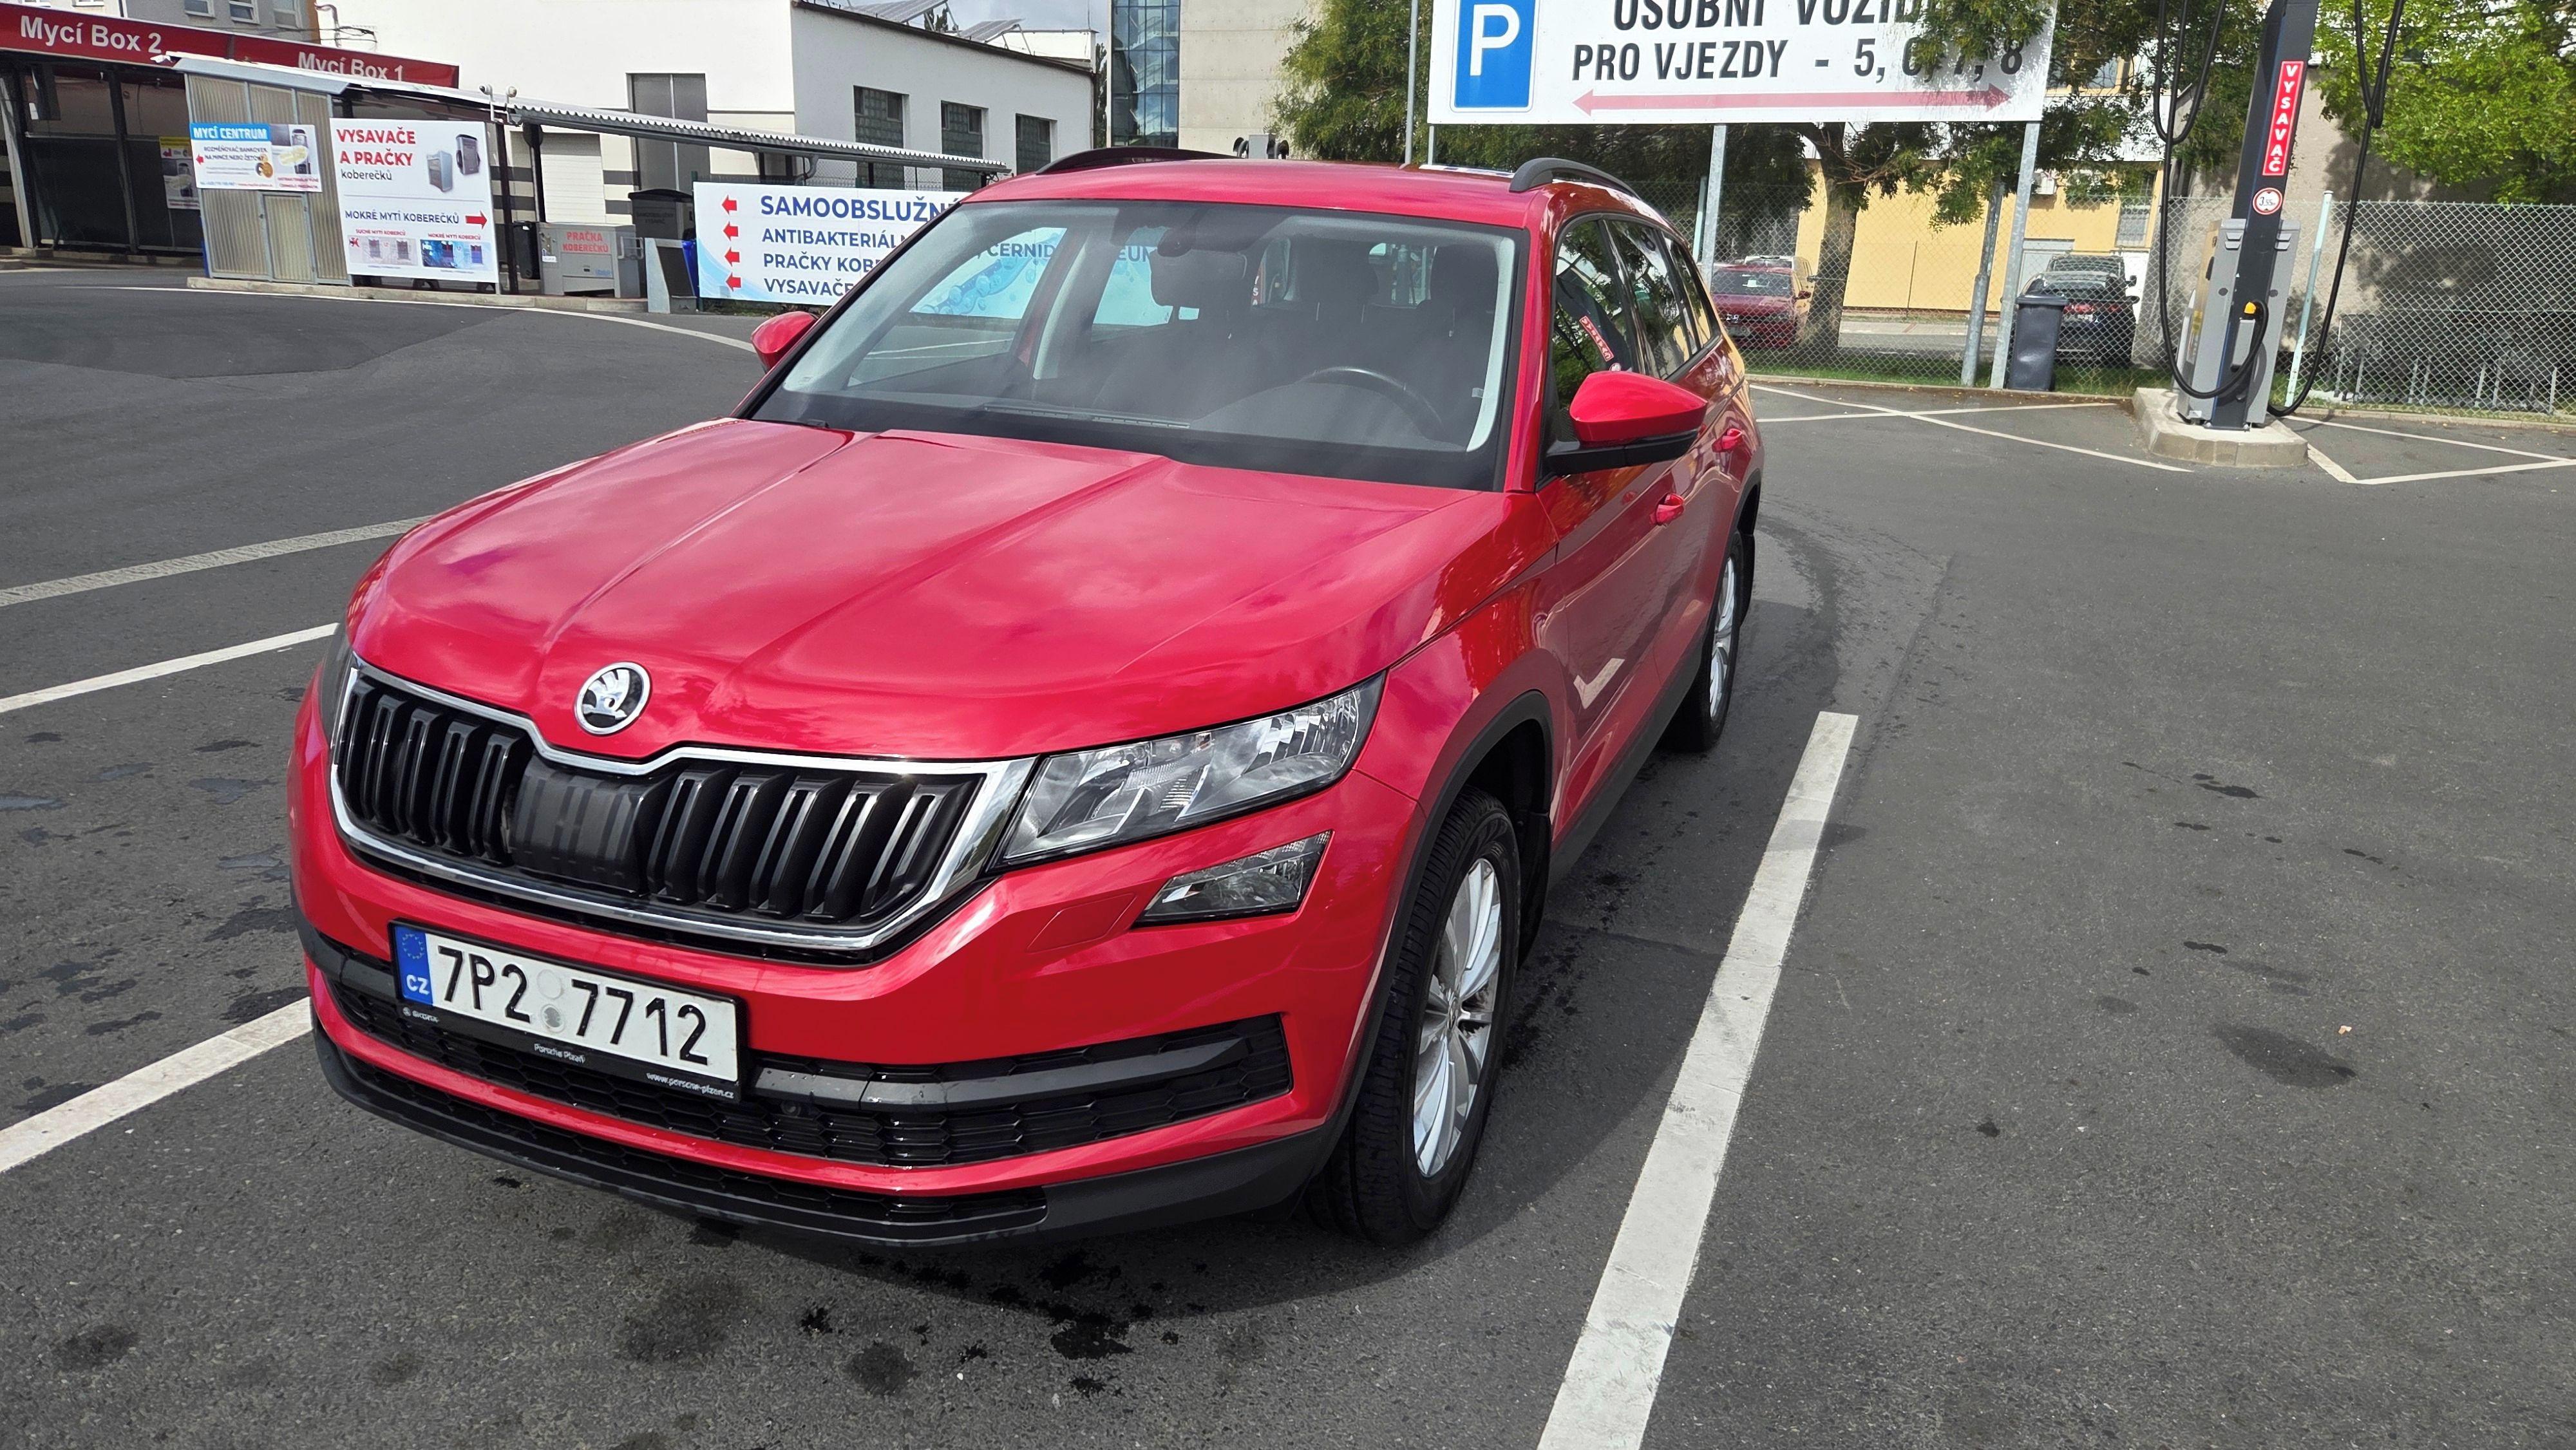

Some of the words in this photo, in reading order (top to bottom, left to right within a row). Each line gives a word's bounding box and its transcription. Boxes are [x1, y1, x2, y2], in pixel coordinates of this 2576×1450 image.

[21, 15, 83, 46] Mycí
[91, 24, 141, 52] Box
[148, 32, 162, 53] 2
[1470, 3, 1520, 76] P
[298, 52, 346, 74] Mycí
[350, 59, 388, 80] Box
[394, 65, 404, 81] 1
[1571, 42, 1640, 81] PRO
[1654, 39, 1788, 80] VJEZDY
[1854, 38, 1885, 84] 5,
[2000, 37, 2024, 75] 8
[2268, 64, 2298, 172] VYSAVAČ
[193, 126, 218, 138] MYCÍ
[220, 128, 268, 140] CENTRUM
[336, 127, 416, 145] VYSAVAČE
[339, 151, 351, 164] A
[354, 148, 413, 165] PRAČKY
[341, 169, 392, 180] koberečků
[345, 209, 377, 220] MOKRÉ
[380, 210, 401, 221] MYTÍ
[404, 212, 459, 224] KOBEREČKŮ
[567, 230, 603, 241] PRAČKA
[763, 251, 832, 271] PRAČKY
[406, 974, 430, 995] CZ
[438, 945, 531, 1024] 7P2
[571, 978, 708, 1066] 7712
